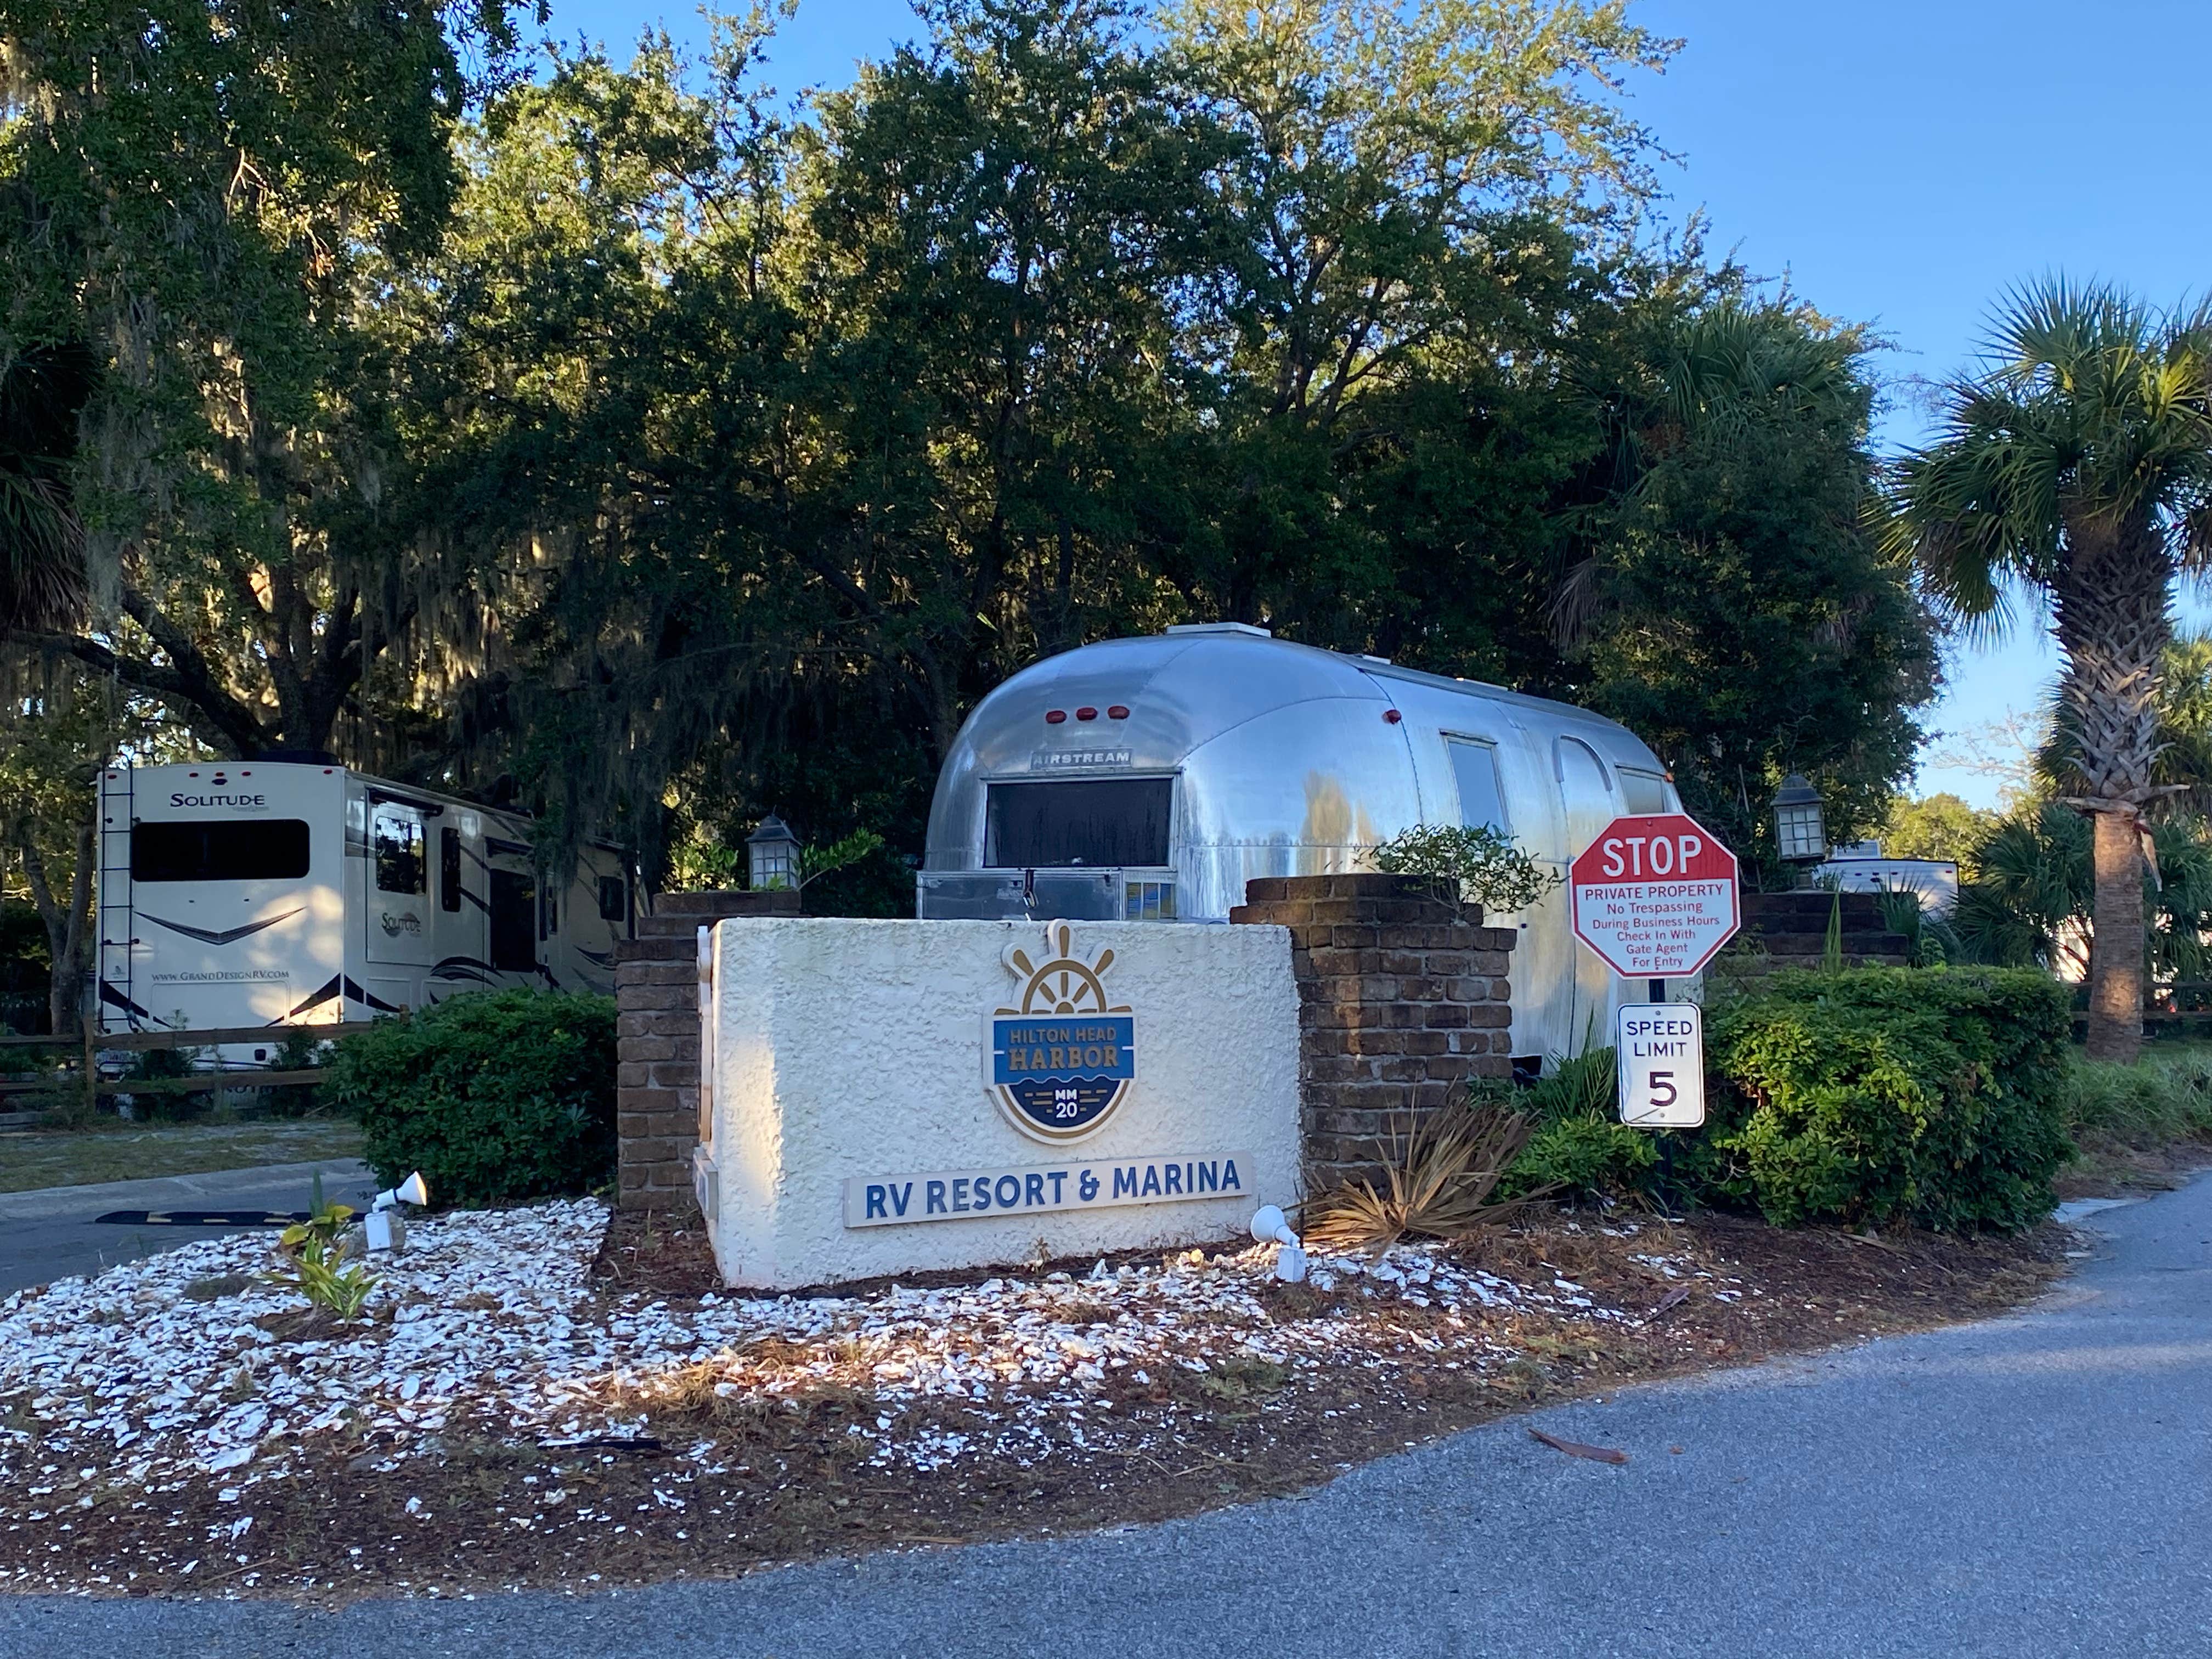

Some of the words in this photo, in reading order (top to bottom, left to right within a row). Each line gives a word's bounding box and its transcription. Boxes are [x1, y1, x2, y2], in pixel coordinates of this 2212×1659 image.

[1034, 752, 1129, 764] AIRSTREAM
[170, 793, 265, 807] SOLITUDE
[1602, 835, 1702, 877] STOP
[1585, 887, 1642, 900] PRIVATE
[1649, 884, 1724, 898] PROPERTY
[1607, 904, 1624, 914] No
[1629, 901, 1703, 915] Trespassing
[1593, 918, 1629, 930] During
[1633, 917, 1682, 927] Business
[1687, 916, 1720, 926] Hours
[1617, 930, 1651, 941] Check
[1656, 931, 1666, 940] In
[1670, 929, 1696, 939] With
[1627, 944, 1652, 954] Gate
[1656, 943, 1688, 955] Agent
[1633, 957, 1650, 967] For
[1655, 957, 1683, 968] Entry
[1010, 1029, 1070, 1045] HILTON
[1075, 1026, 1117, 1043] HEAD
[1627, 1020, 1692, 1036] SPEED
[1634, 1042, 1687, 1057] LIMIT
[1008, 1046, 1119, 1071] HARBOR
[1055, 1089, 1077, 1101] MM
[1650, 1071, 1677, 1106] 5
[1056, 1103, 1077, 1118] 20
[866, 1182, 913, 1219] RV
[927, 1172, 1068, 1214] RESORT
[1079, 1169, 1100, 1202] &
[1113, 1159, 1241, 1199] MARINA
